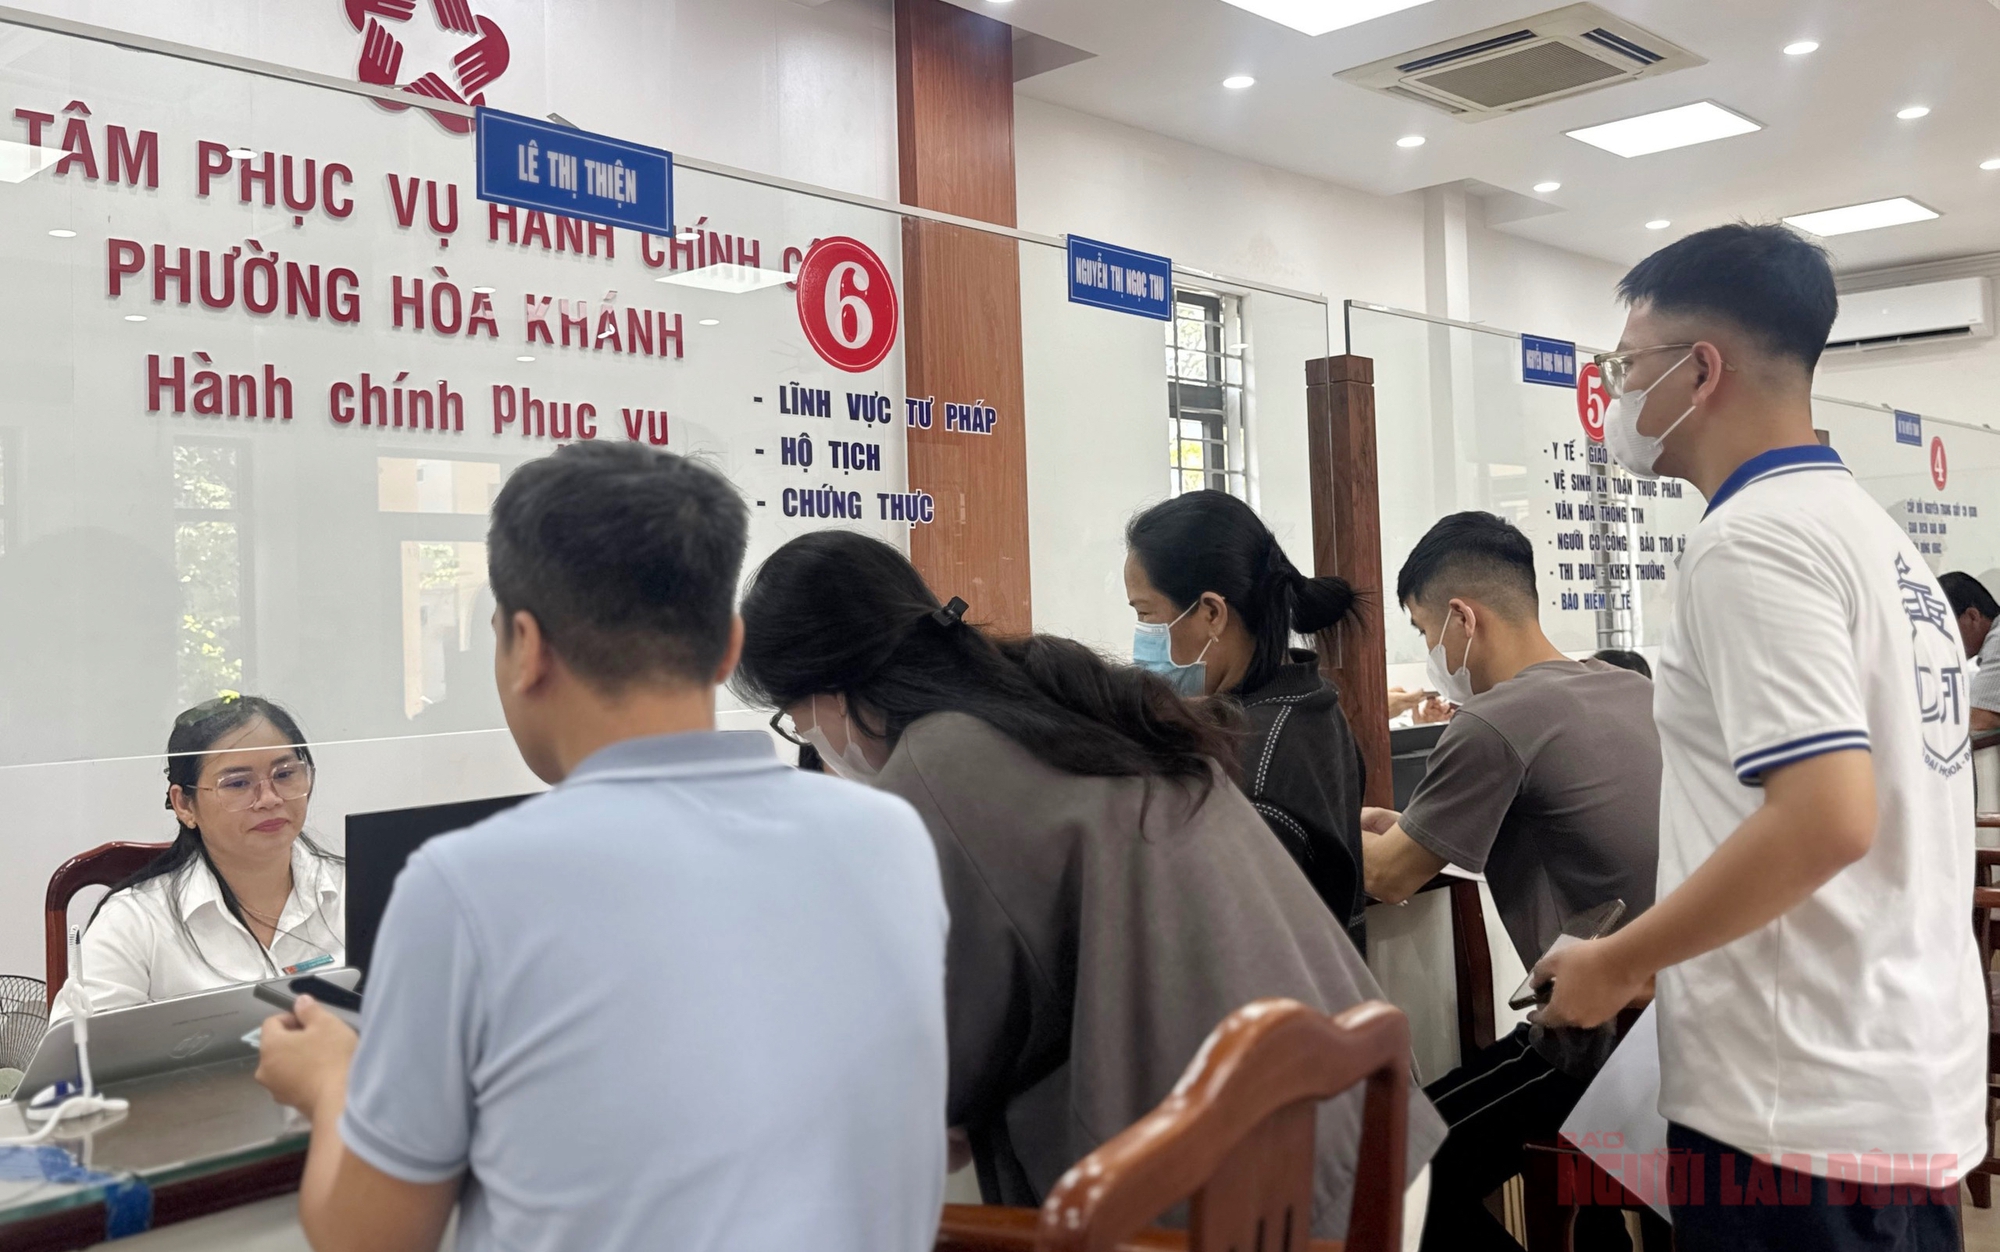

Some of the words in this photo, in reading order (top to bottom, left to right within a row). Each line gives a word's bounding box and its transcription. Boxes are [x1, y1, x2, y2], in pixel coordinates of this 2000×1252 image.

[14, 100, 159, 189] TÂM
[196, 140, 354, 226] PHỤC
[387, 173, 459, 248] VỤ
[518, 139, 540, 184] LÊ
[547, 151, 578, 199] THỊ
[584, 159, 637, 209] THIỆN
[107, 238, 360, 323] PHƯỜNG
[392, 266, 499, 337] HÒA
[525, 290, 684, 359] KHÁNH
[1075, 252, 1108, 290] NGUYỄN
[1110, 264, 1124, 298] THỊ
[1126, 268, 1147, 302] NGỌC
[1149, 273, 1165, 302] THU
[824, 260, 874, 351] 6
[147, 351, 293, 420] Hành
[330, 371, 464, 432] chính
[779, 381, 832, 418] LĨNH
[846, 391, 892, 429] VỰC
[905, 396, 935, 430] TƯ
[945, 400, 997, 435] PHÁP
[1587, 374, 1605, 429] 5
[781, 432, 813, 473] HỘ
[828, 440, 881, 476] TỊCH
[1552, 442, 1559, 460] Y
[1564, 439, 1576, 461] TẾ
[1588, 443, 1608, 464] GIÁO
[1934, 445, 1944, 482] 4
[1553, 469, 1566, 494] VỆ
[1571, 474, 1592, 492] SINH
[1596, 476, 1608, 493] AN
[782, 483, 862, 519] CHỨNG
[877, 489, 935, 528] THỰC
[1555, 500, 1573, 521] VĂN
[1631, 506, 1645, 524] TIN
[1557, 529, 1584, 550] NGƯỜI
[1639, 531, 1655, 552] BẢO
[1558, 562, 1573, 580] THI
[1578, 563, 1597, 580] ĐUA
[1609, 563, 1631, 581] KHEN
[1561, 587, 1579, 611] BẢO
